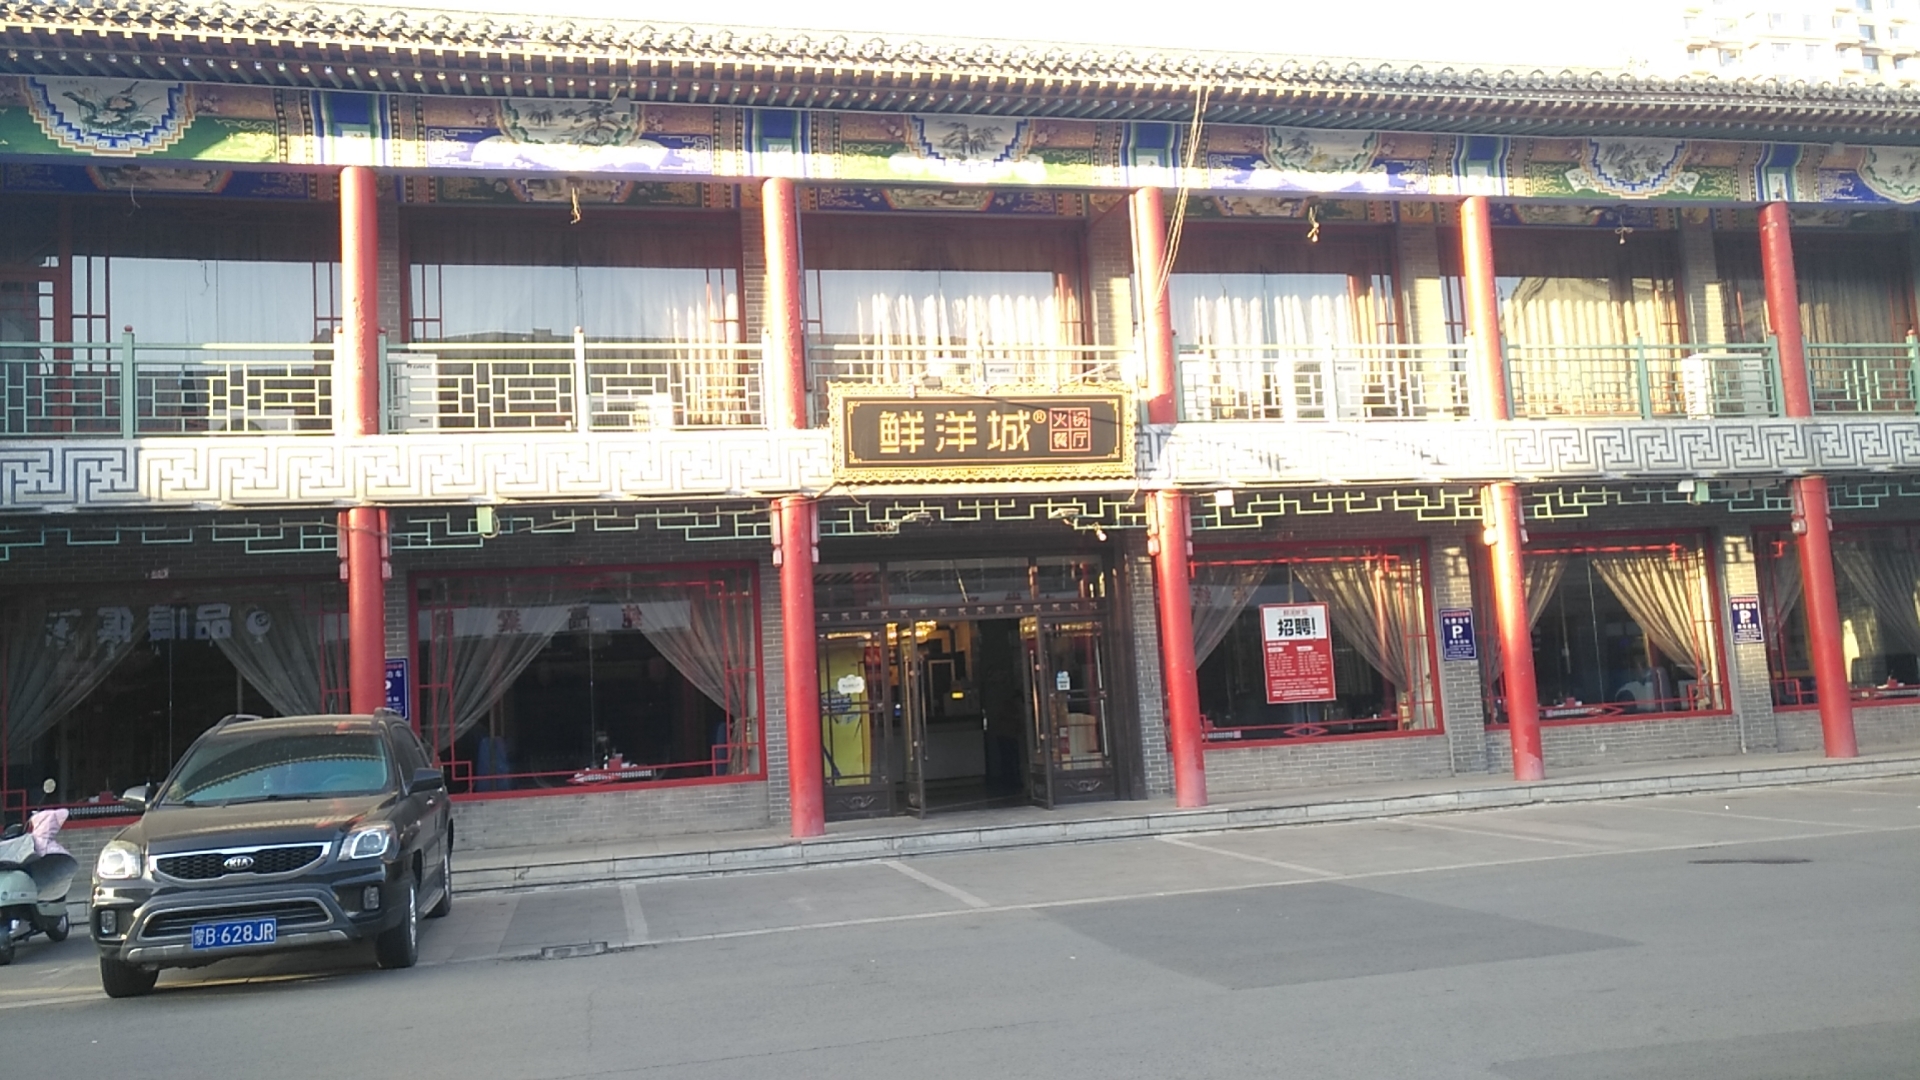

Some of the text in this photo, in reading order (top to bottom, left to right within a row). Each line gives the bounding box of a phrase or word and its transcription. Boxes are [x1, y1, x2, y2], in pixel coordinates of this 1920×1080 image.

[1053, 411, 1088, 428] 火锅
[878, 409, 1031, 453] 鲜洋城
[1053, 431, 1088, 449] 餐厅
[1740, 610, 1751, 624] P
[1452, 625, 1463, 639] P
